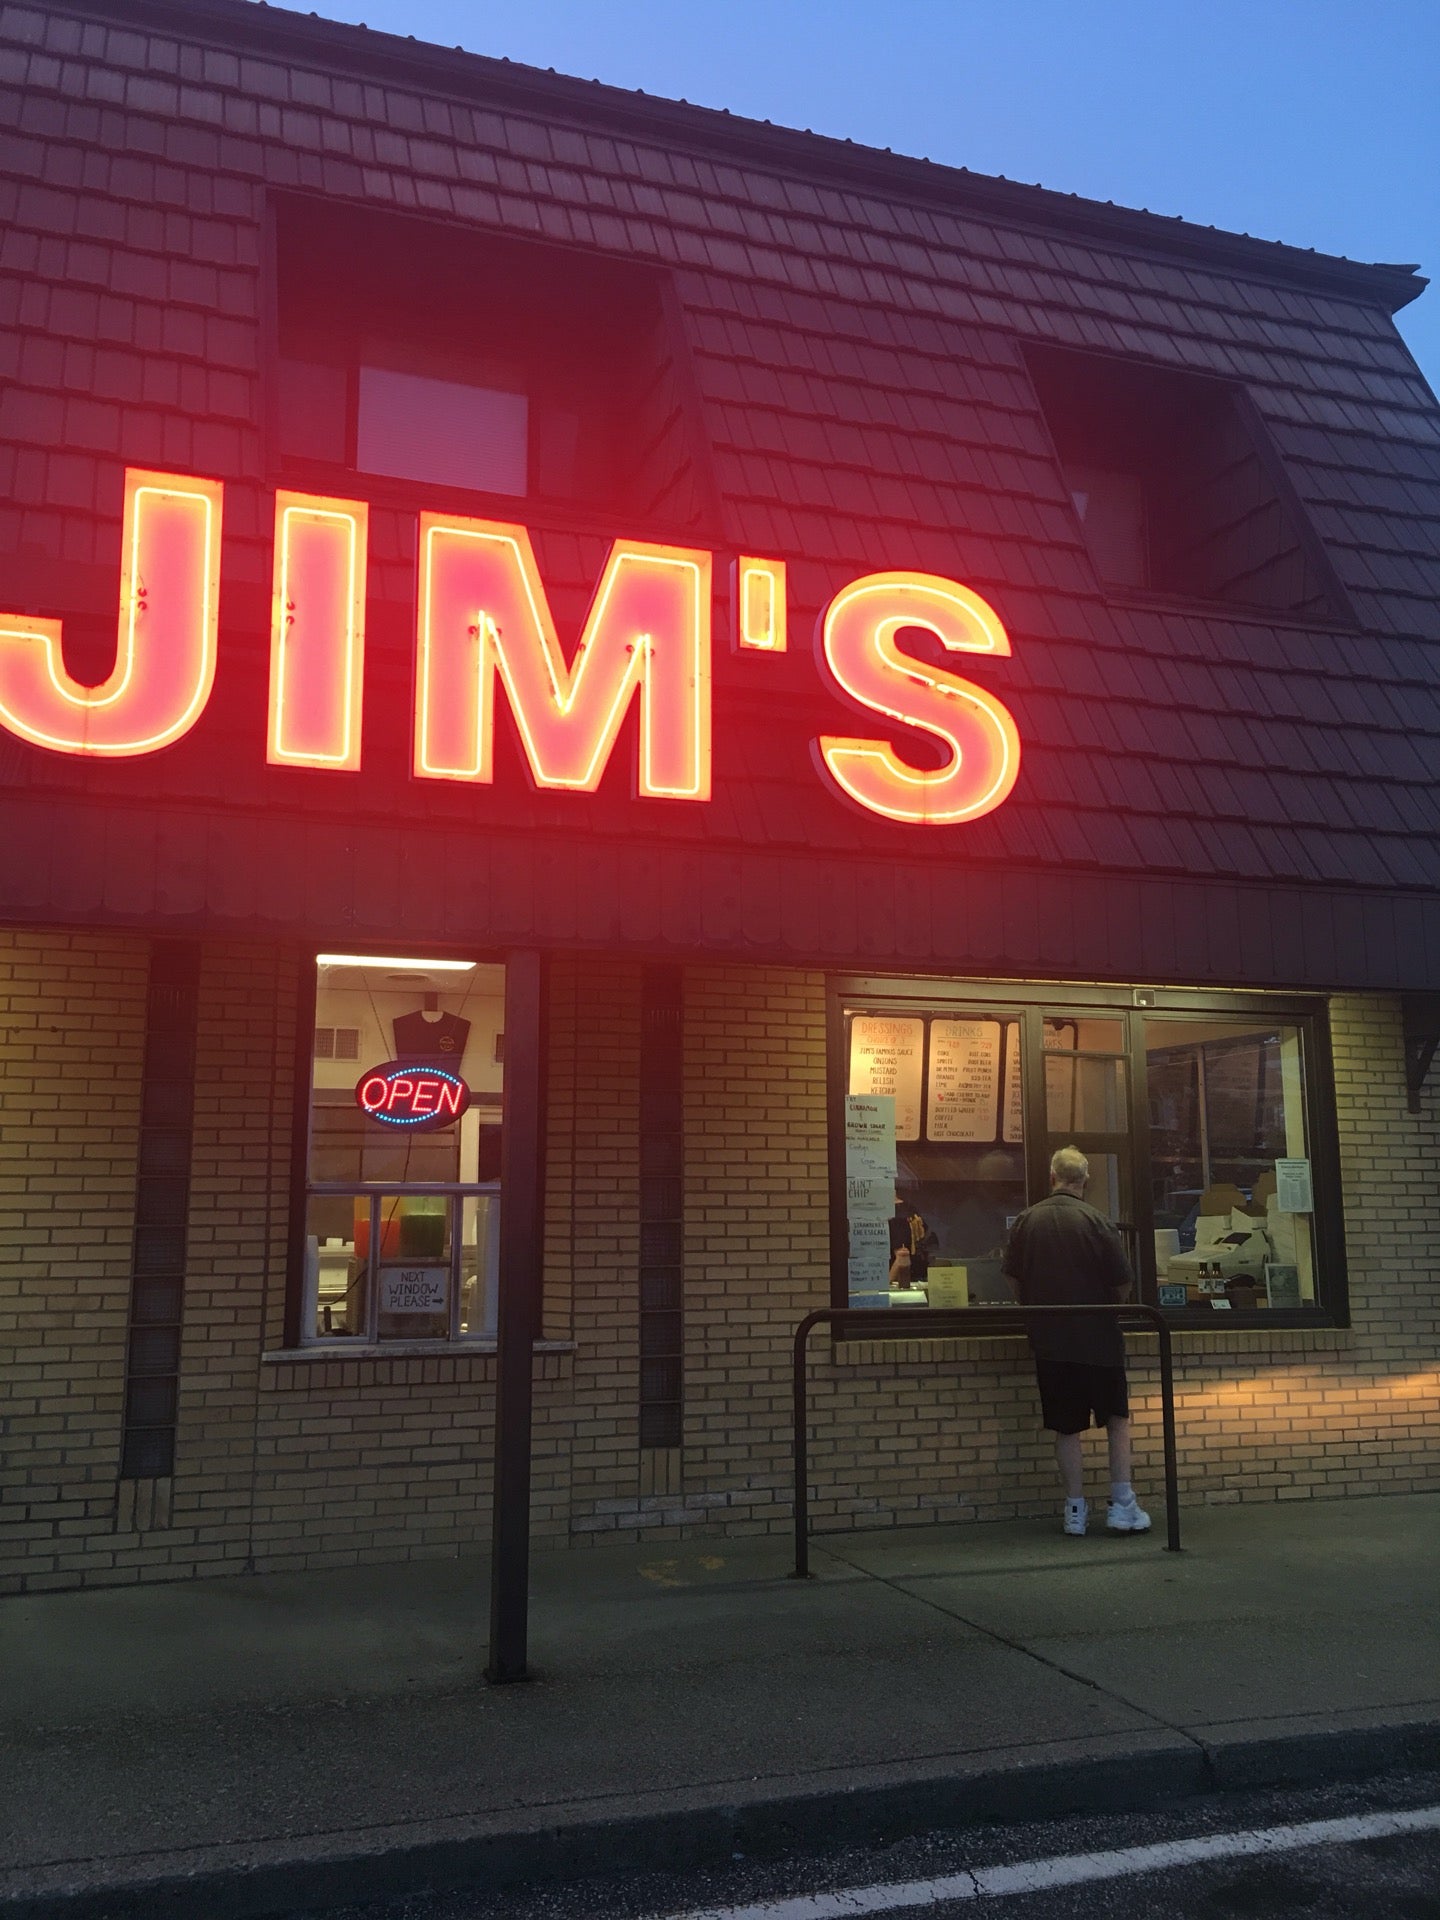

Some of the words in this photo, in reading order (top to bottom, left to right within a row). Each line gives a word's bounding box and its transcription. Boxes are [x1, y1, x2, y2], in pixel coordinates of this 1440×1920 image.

[0, 466, 1022, 828] JIM'S
[861, 1022, 913, 1034] DRESSINGS
[945, 1026, 983, 1037] DRINKS
[873, 1057, 898, 1065] ONIONS
[870, 1066, 898, 1075] MUSTARD
[872, 1076, 895, 1085] RELISH
[871, 1086, 897, 1095] KETCHUP
[361, 1077, 463, 1115] OPEN
[849, 1104, 878, 1112] CINNAMON
[847, 1121, 868, 1129] BROWN
[849, 1180, 873, 1189] MINT
[848, 1188, 869, 1198] CHIP
[401, 1271, 425, 1282] NEXT
[389, 1283, 439, 1295] WINDOW
[389, 1296, 430, 1308] PLEASE
